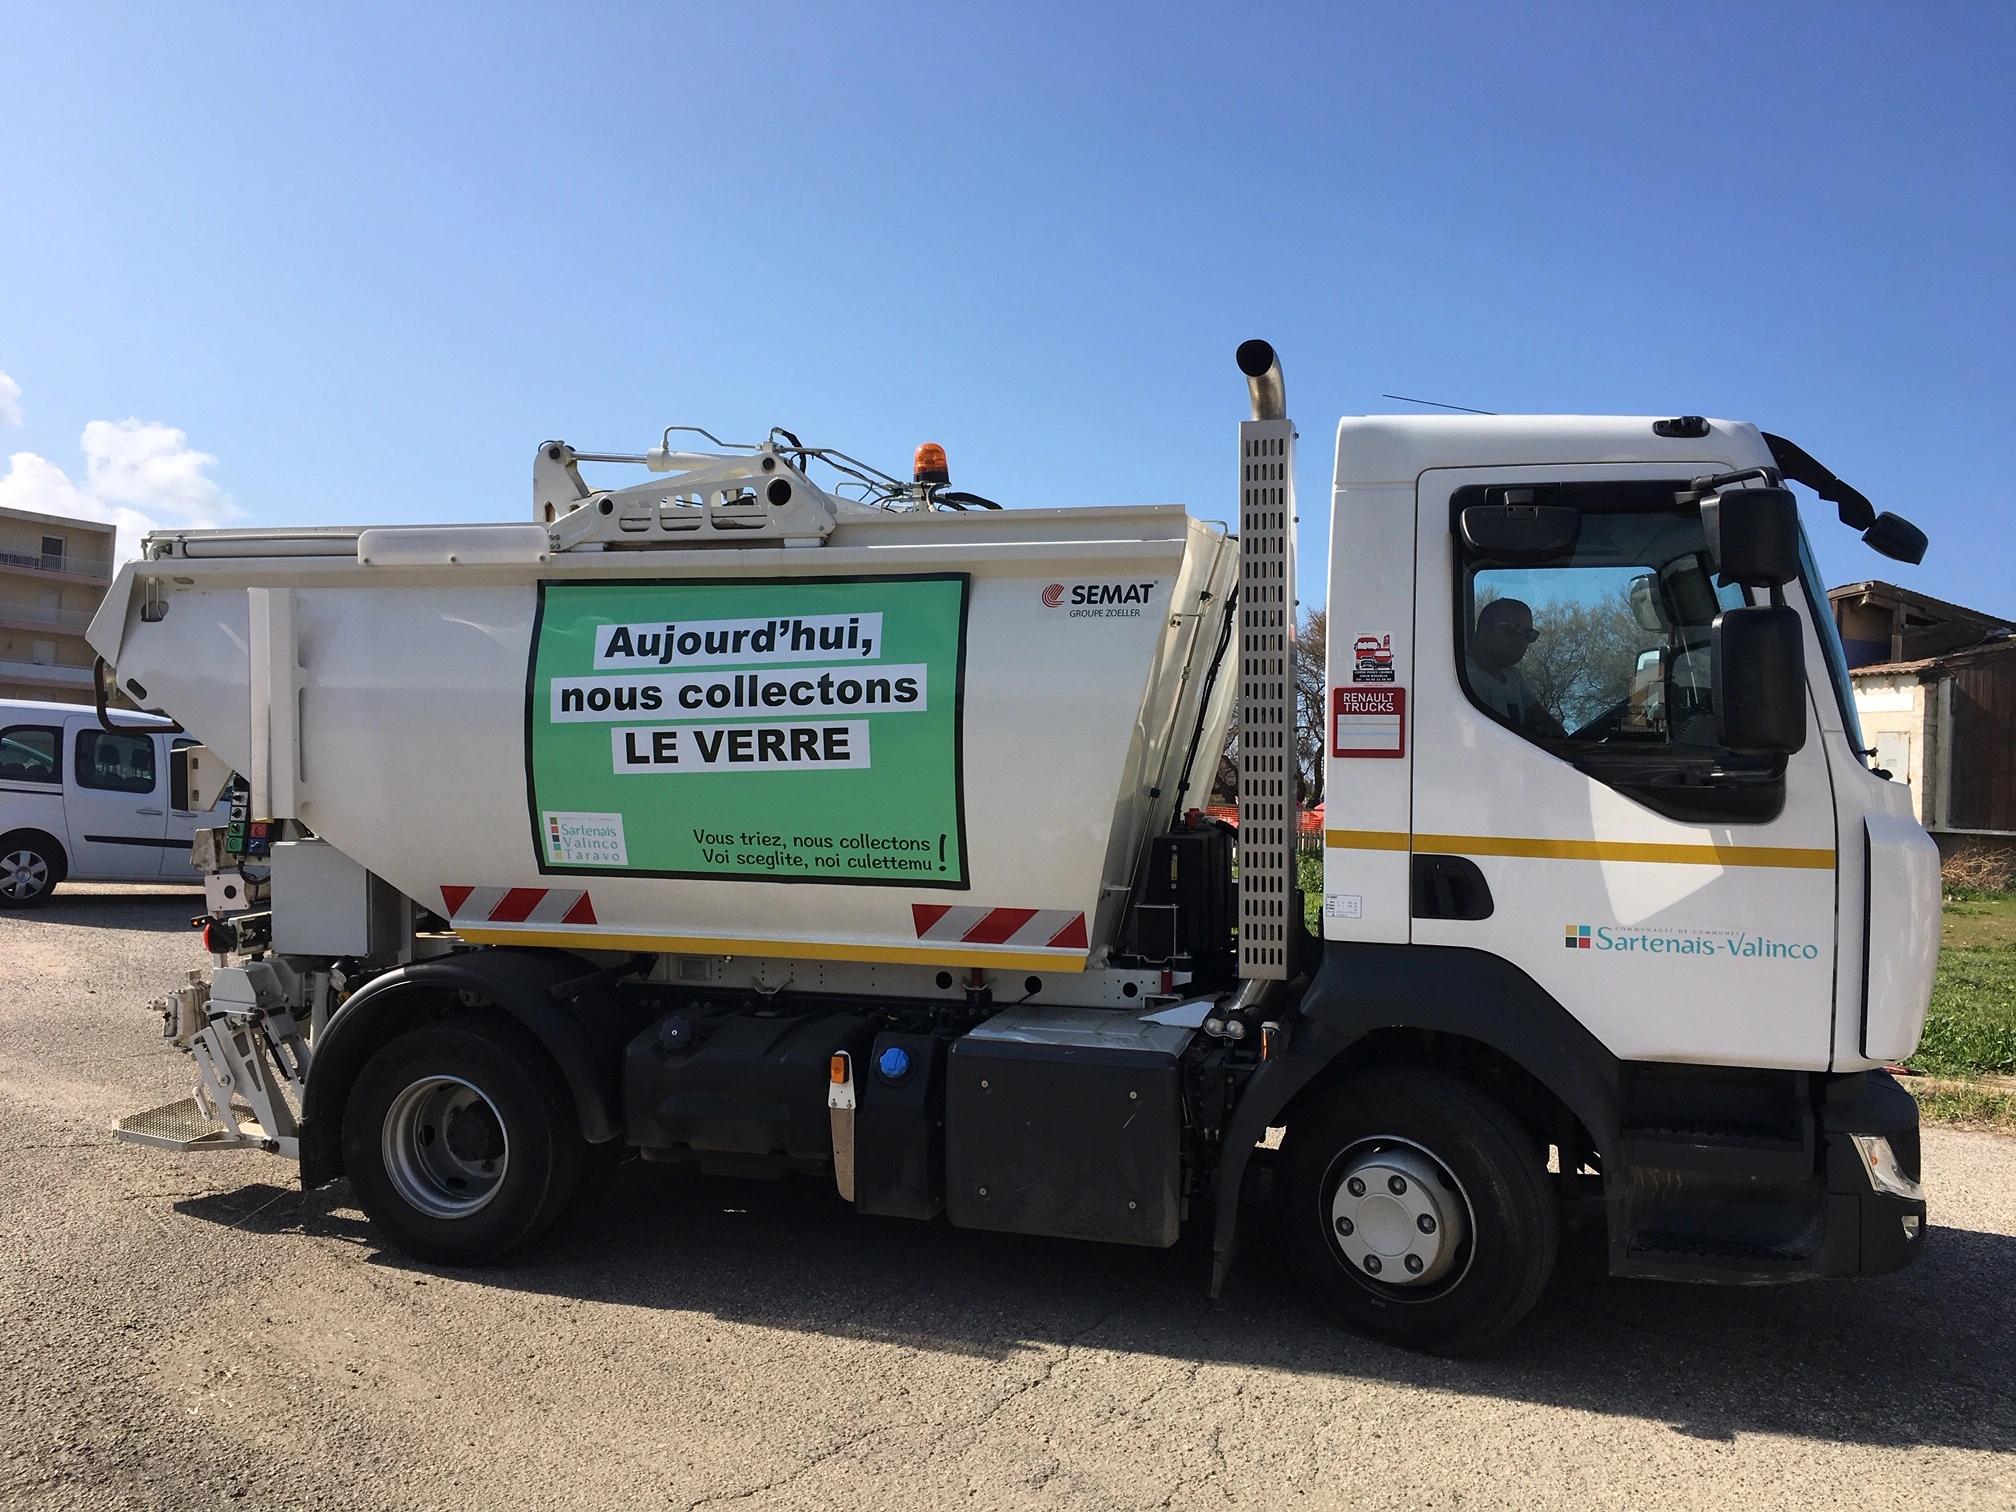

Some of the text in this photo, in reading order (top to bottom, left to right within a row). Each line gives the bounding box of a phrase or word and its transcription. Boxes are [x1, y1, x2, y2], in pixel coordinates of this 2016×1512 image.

[1071, 584, 1154, 604] SEMAT
[1070, 609, 1140, 617] GROUPE ZOELLER
[604, 618, 872, 664] Aujourd'hui,
[561, 673, 918, 712] nous collectons
[1343, 693, 1394, 702] RENAULT
[1343, 702, 1394, 712] TRUCKS
[625, 727, 850, 764] LE VERRE
[561, 824, 617, 837] Sartenais
[693, 829, 735, 845] Vous
[740, 832, 787, 849] triez,
[793, 836, 833, 848] nous
[840, 834, 930, 850] collectons
[563, 837, 618, 849] Valinco
[564, 849, 620, 861] Taravo
[702, 849, 932, 871] Voi sceglite, noi culettemu
[1596, 926, 1818, 960] Sartenais-Valinco
